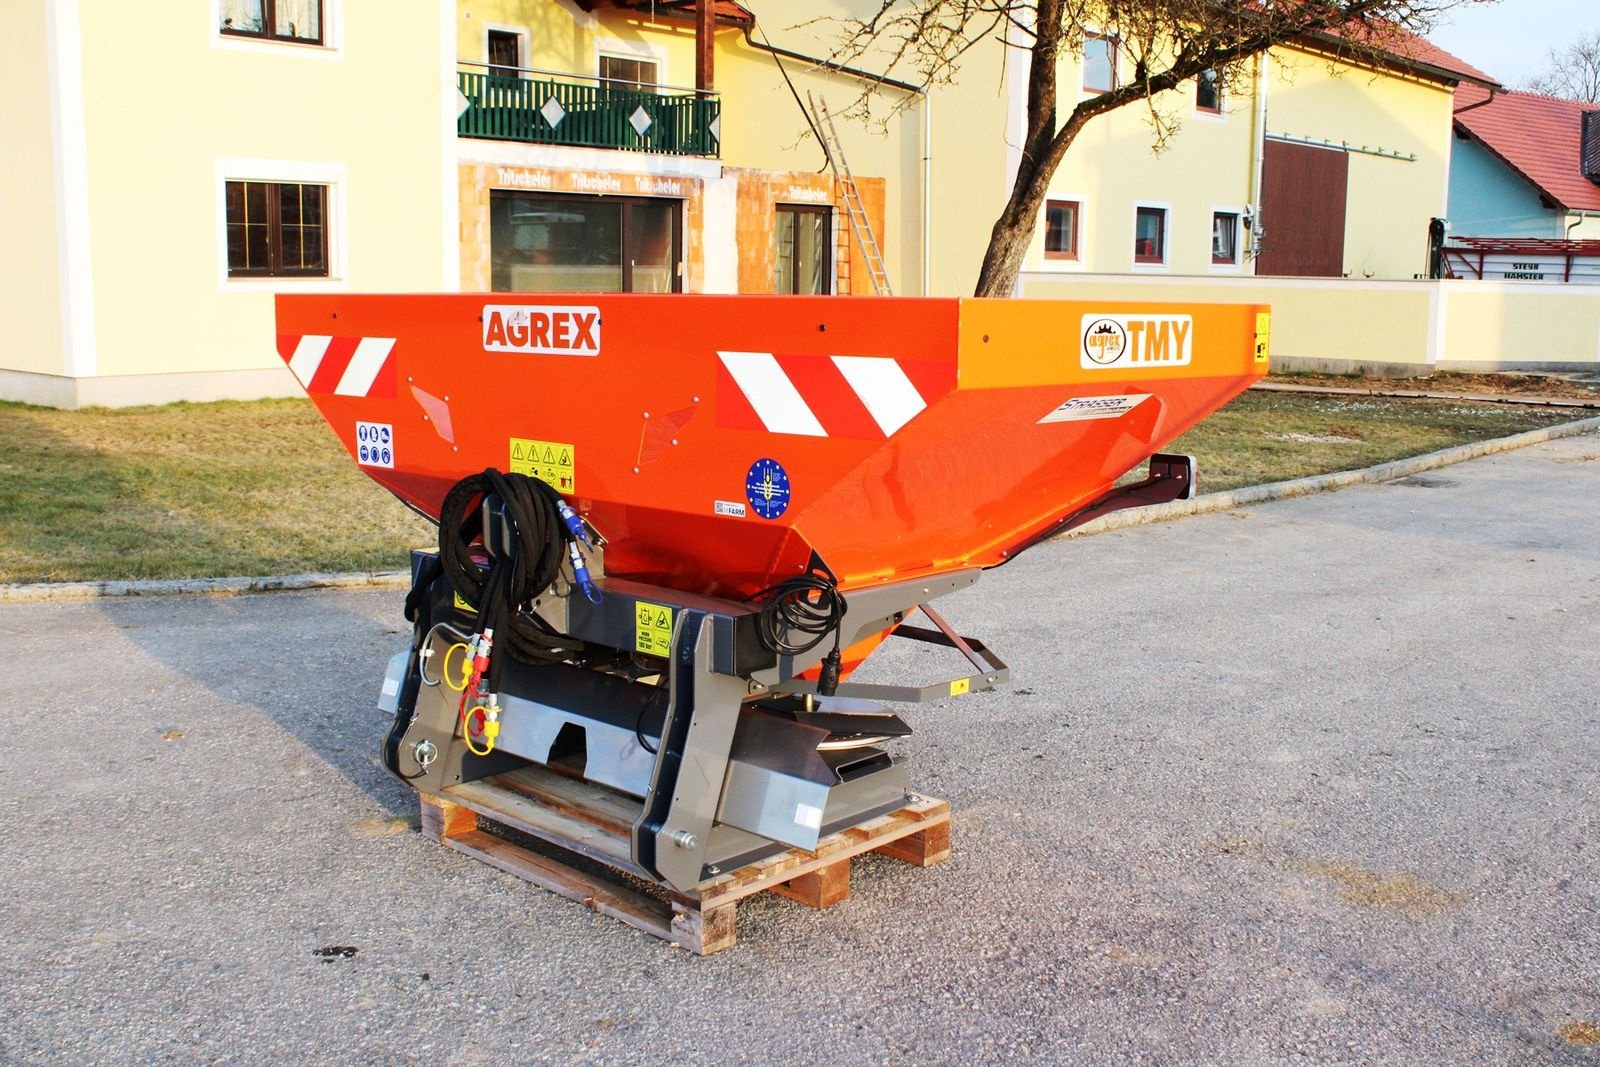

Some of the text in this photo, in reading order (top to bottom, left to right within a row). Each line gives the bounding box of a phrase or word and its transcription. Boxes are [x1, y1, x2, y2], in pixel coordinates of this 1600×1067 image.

[1504, 272, 1544, 280] HAMSTER
[485, 311, 597, 350] AGREX
[1127, 321, 1190, 362] TMY
